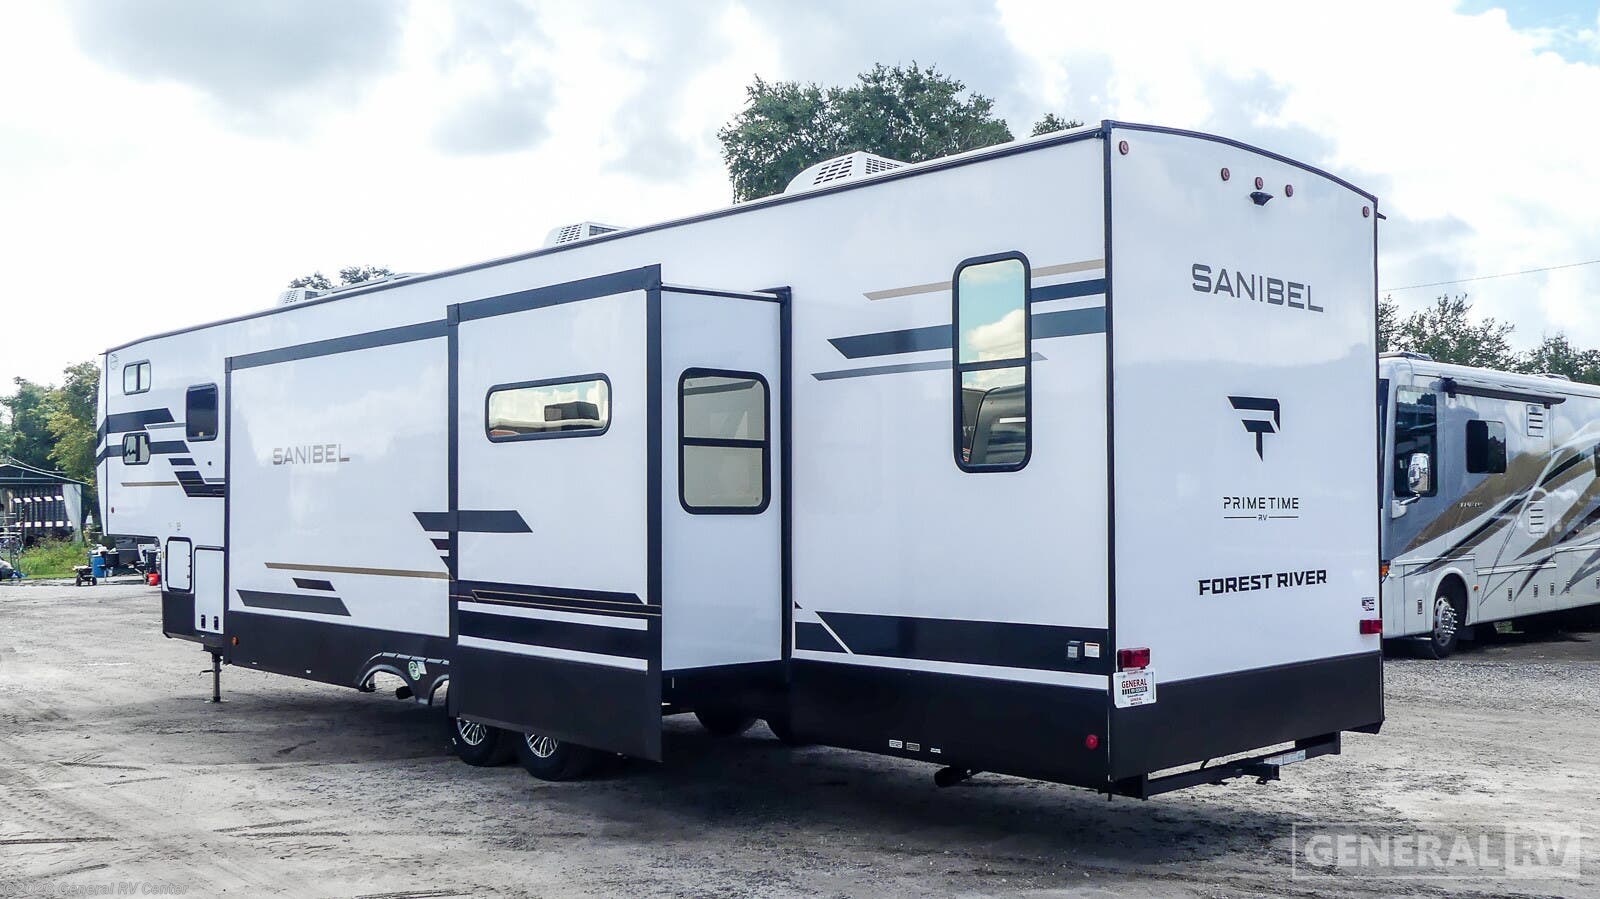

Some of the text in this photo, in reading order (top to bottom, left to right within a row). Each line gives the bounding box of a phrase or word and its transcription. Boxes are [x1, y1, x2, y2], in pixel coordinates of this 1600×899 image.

[1192, 263, 1324, 313] SANIBEL
[272, 444, 350, 466] SANIBEL
[1198, 569, 1327, 596] FOREST RIVER
[1121, 678, 1148, 689] GENERAL
